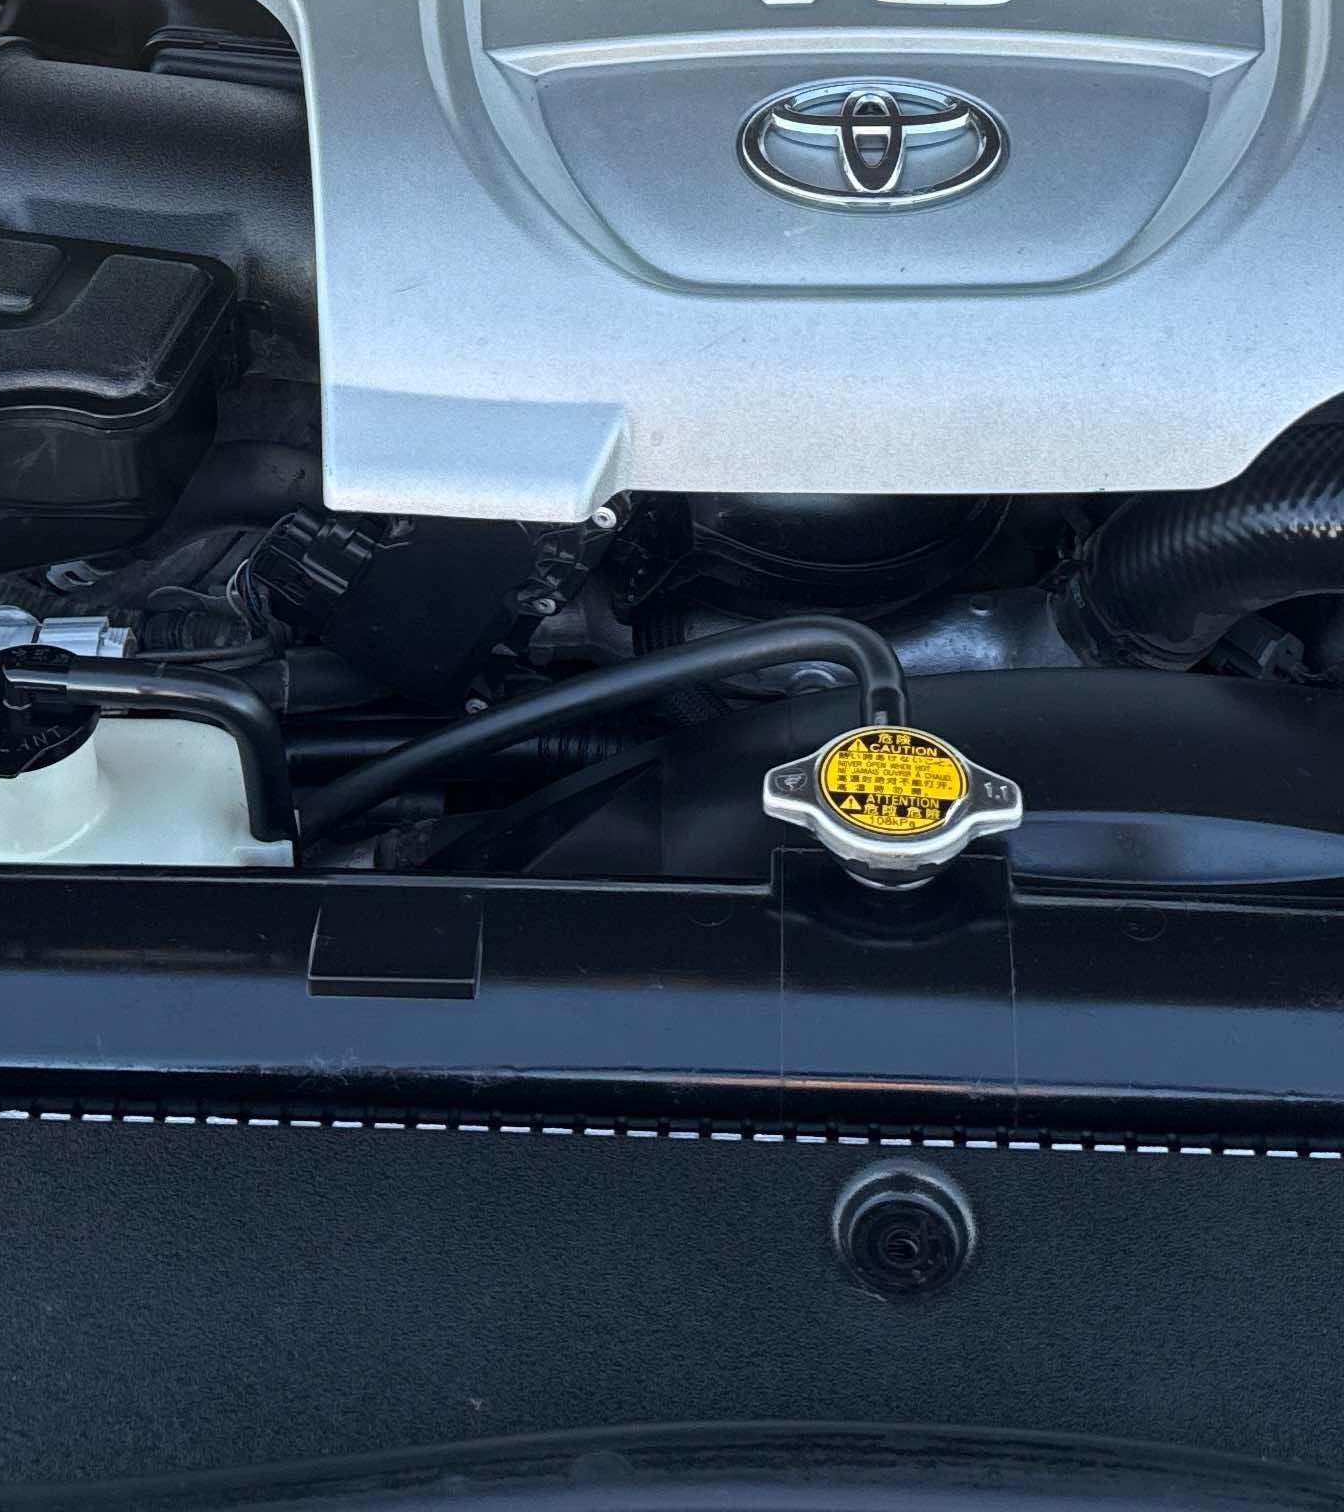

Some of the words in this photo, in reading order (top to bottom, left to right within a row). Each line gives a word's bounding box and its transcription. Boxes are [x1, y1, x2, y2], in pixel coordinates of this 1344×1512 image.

[869, 743, 938, 757] CAUTION
[866, 794, 940, 809] ATTENTION
[870, 816, 916, 828] 108kPa
